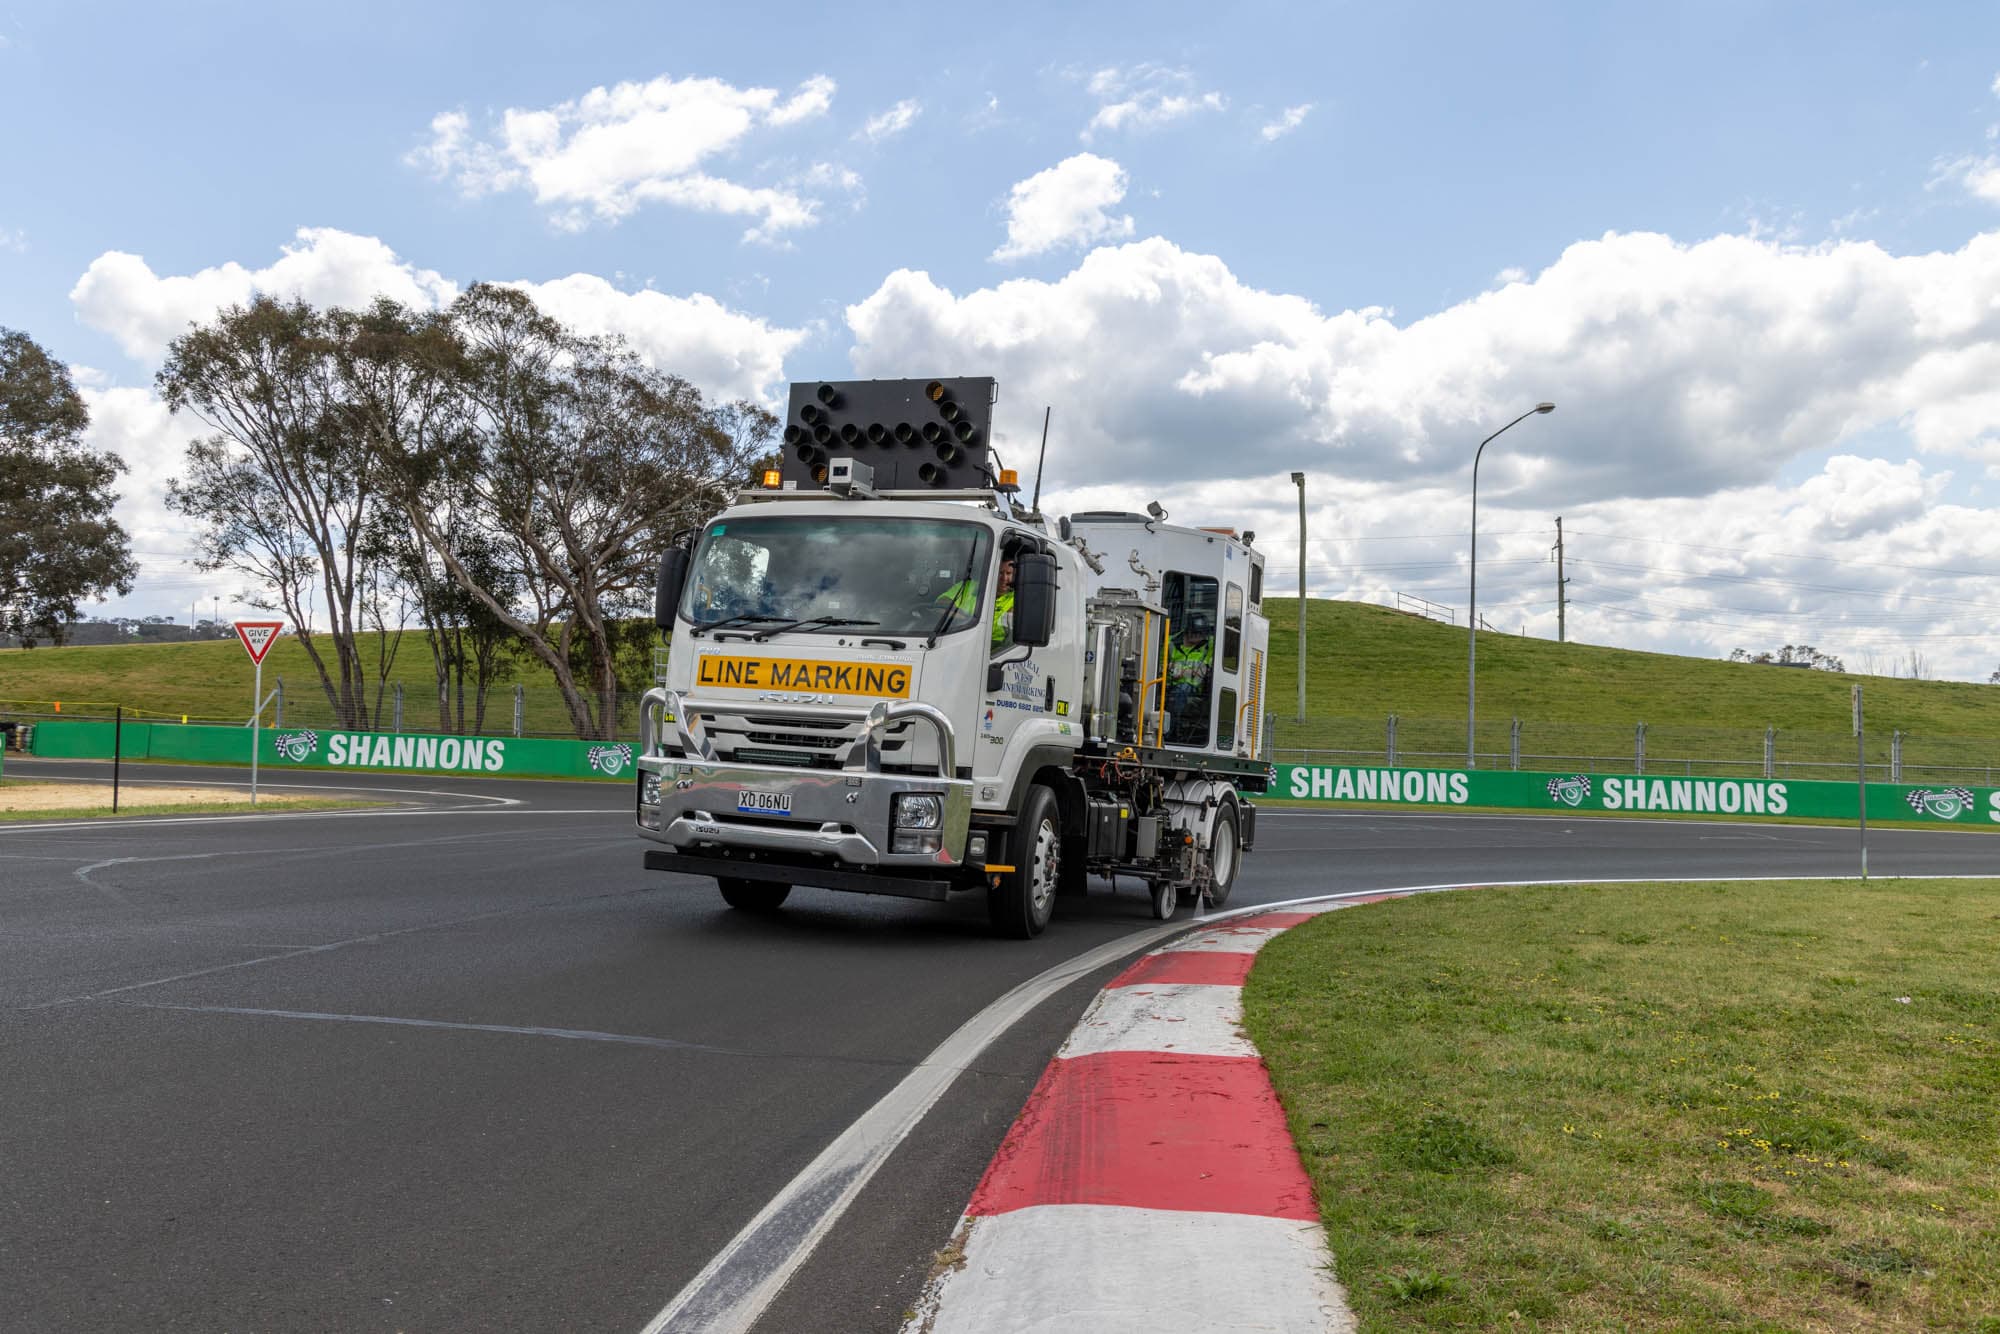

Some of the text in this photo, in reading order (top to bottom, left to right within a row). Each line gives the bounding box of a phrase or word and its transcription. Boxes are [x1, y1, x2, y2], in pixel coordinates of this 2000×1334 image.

[248, 629, 269, 637] GIVE
[701, 659, 906, 694] LINE MARKING
[996, 699, 1018, 709] DUBBO
[327, 734, 505, 771] SHANNONS
[1290, 766, 1469, 804] SHANNONS
[1602, 777, 1788, 815] SHANNONS
[695, 826, 720, 834] ISUZU
